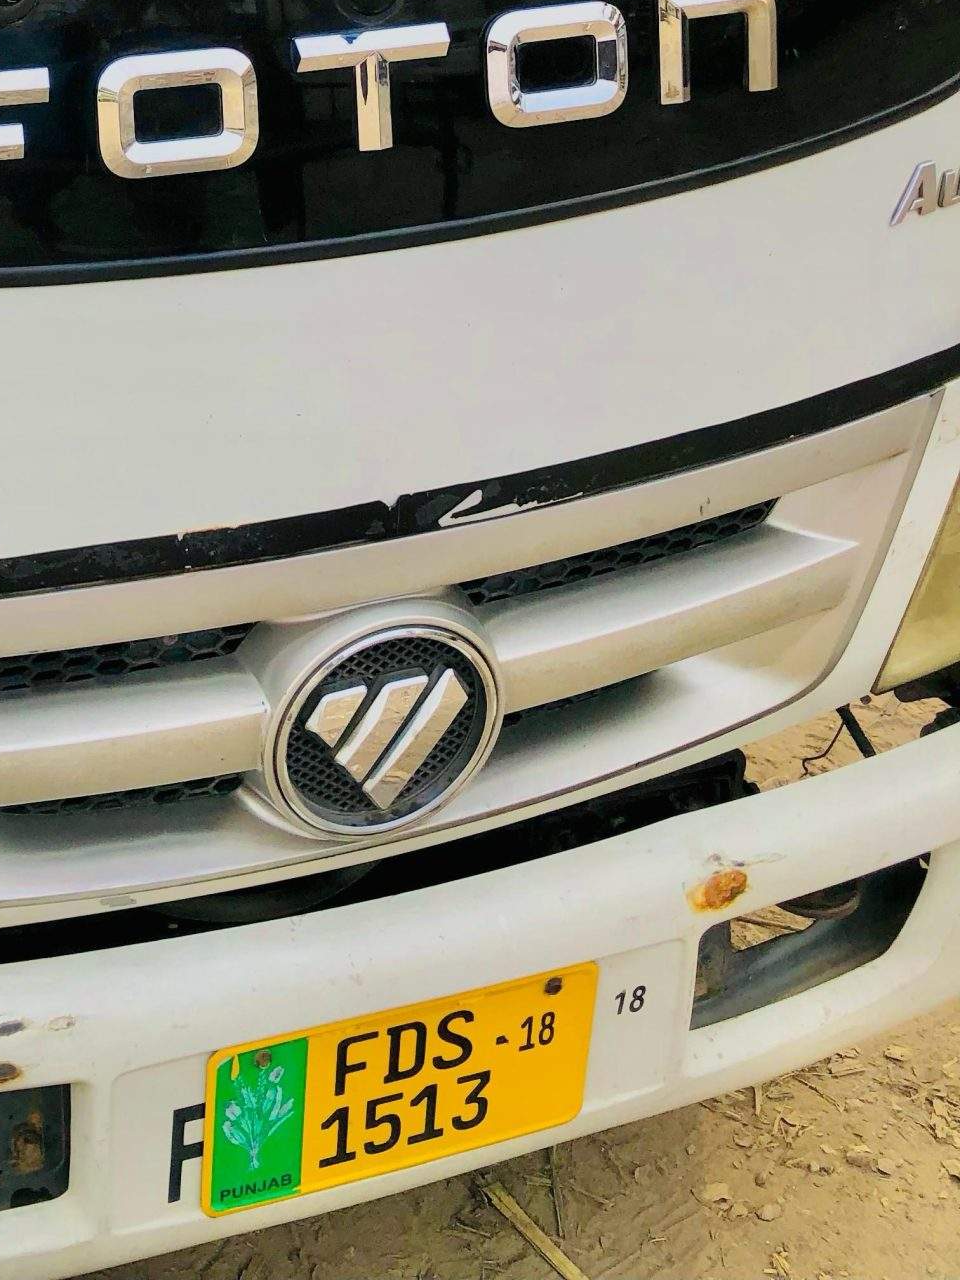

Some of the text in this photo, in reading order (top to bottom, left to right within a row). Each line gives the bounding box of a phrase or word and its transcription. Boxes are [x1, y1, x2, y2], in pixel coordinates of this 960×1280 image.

[614, 985, 647, 1015] 18
[334, 1010, 476, 1096] FDS
[318, 1070, 492, 1169] 1513
[219, 1173, 293, 1203] PUNJAB
